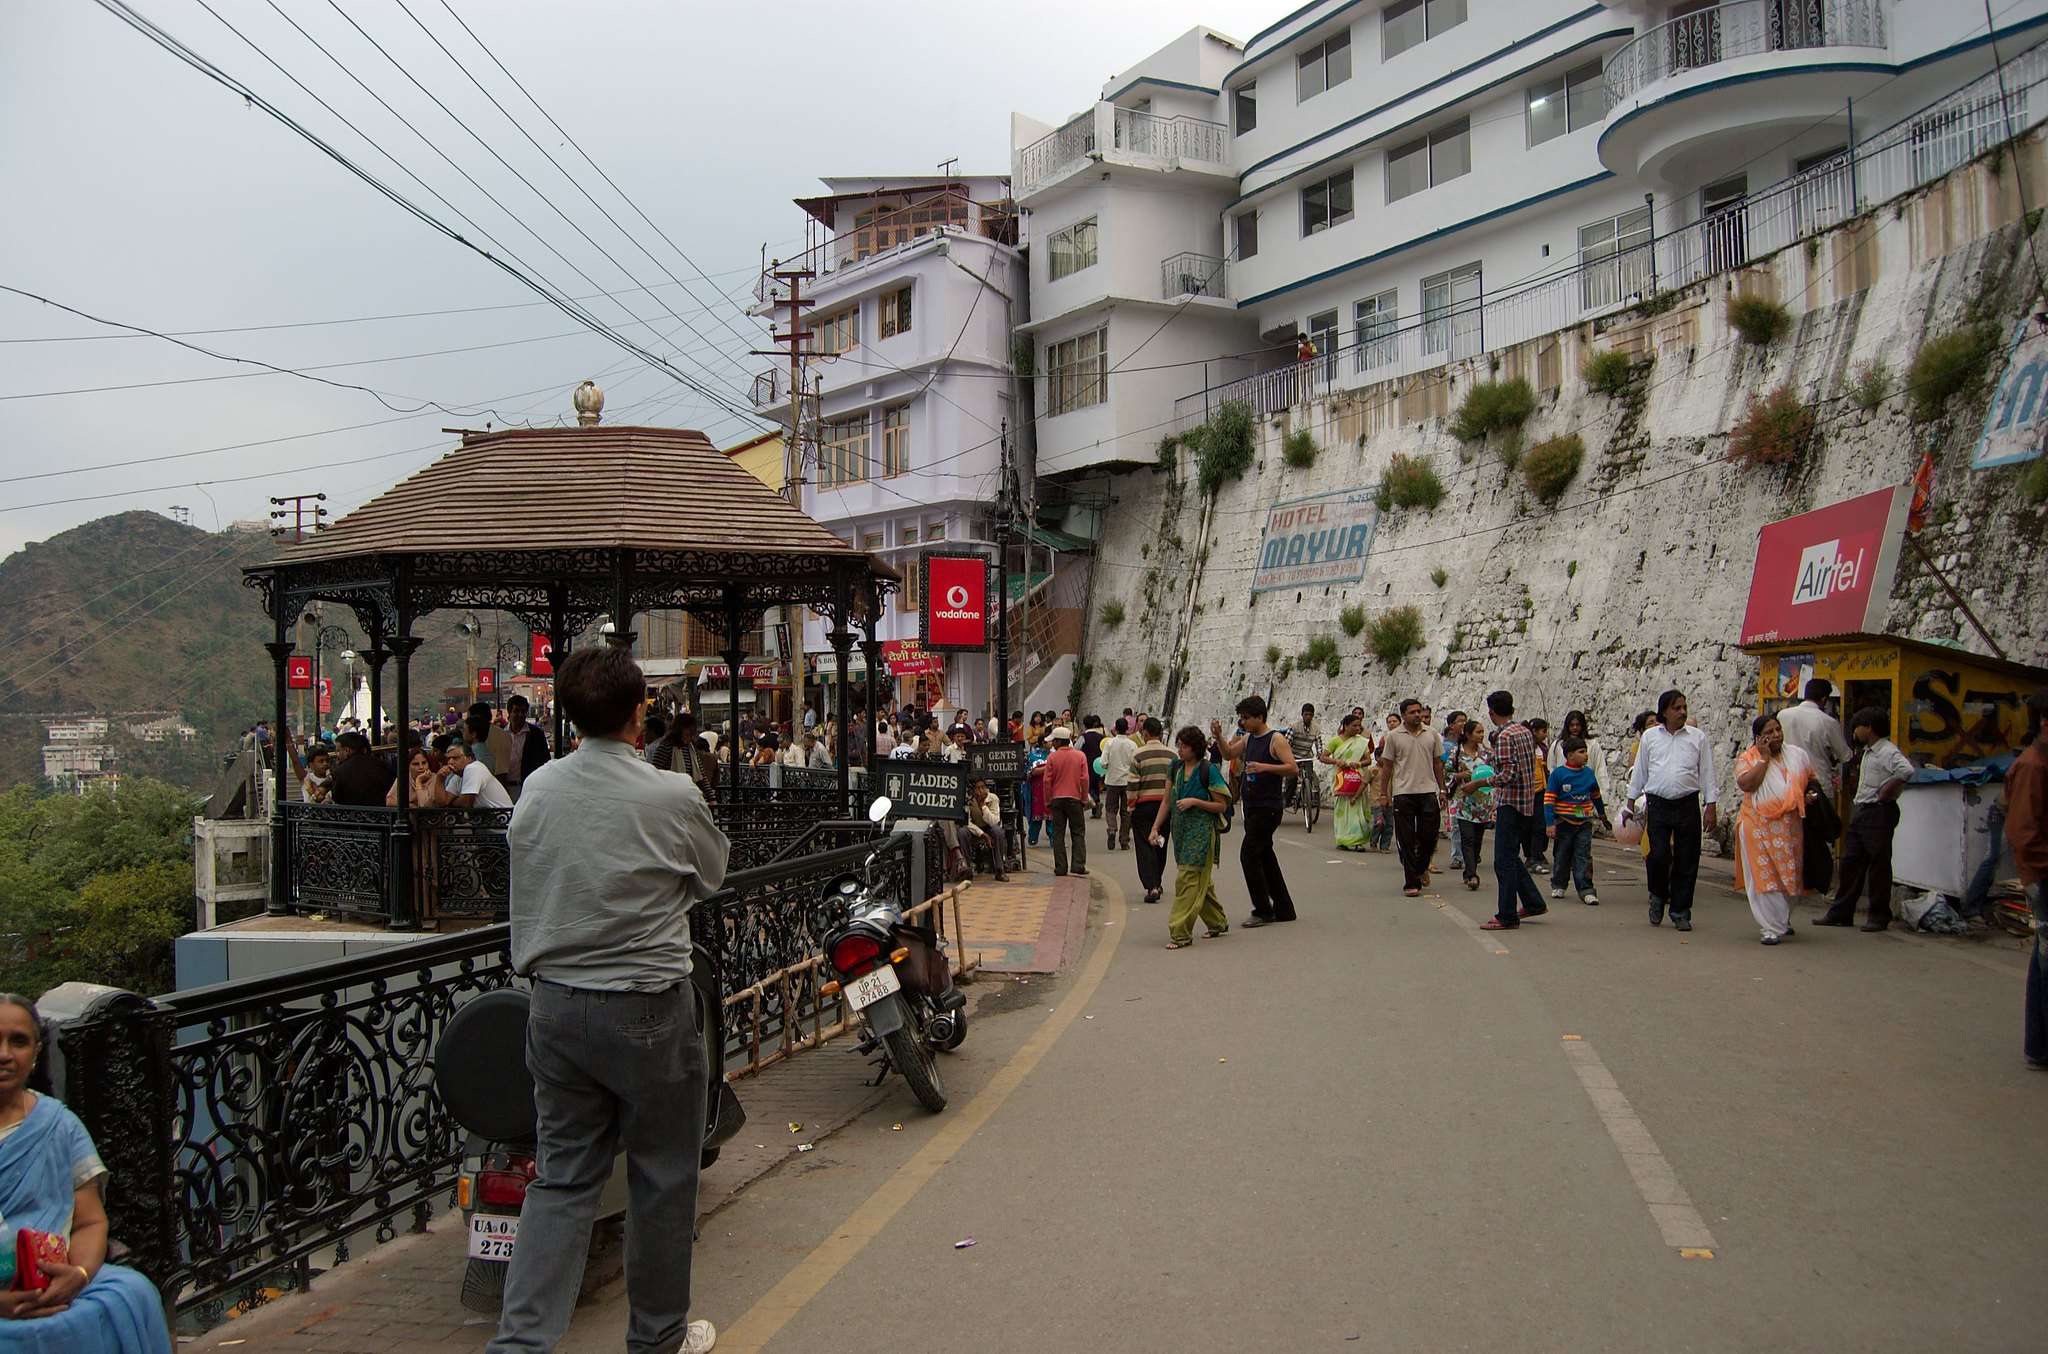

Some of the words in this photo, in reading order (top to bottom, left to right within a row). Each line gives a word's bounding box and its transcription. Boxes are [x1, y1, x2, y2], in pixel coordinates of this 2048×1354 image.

[1271, 504, 1328, 532] HOTEL
[1263, 524, 1368, 569] MAYUR
[1796, 548, 1864, 600] Airtel
[936, 609, 980, 619] vodafone
[988, 750, 1017, 760] GENTS
[987, 762, 1018, 772] TOILET
[910, 773, 958, 790] LADIES
[908, 792, 957, 809] TOILET
[858, 981, 870, 994] UP
[480, 1239, 514, 1257] 273
